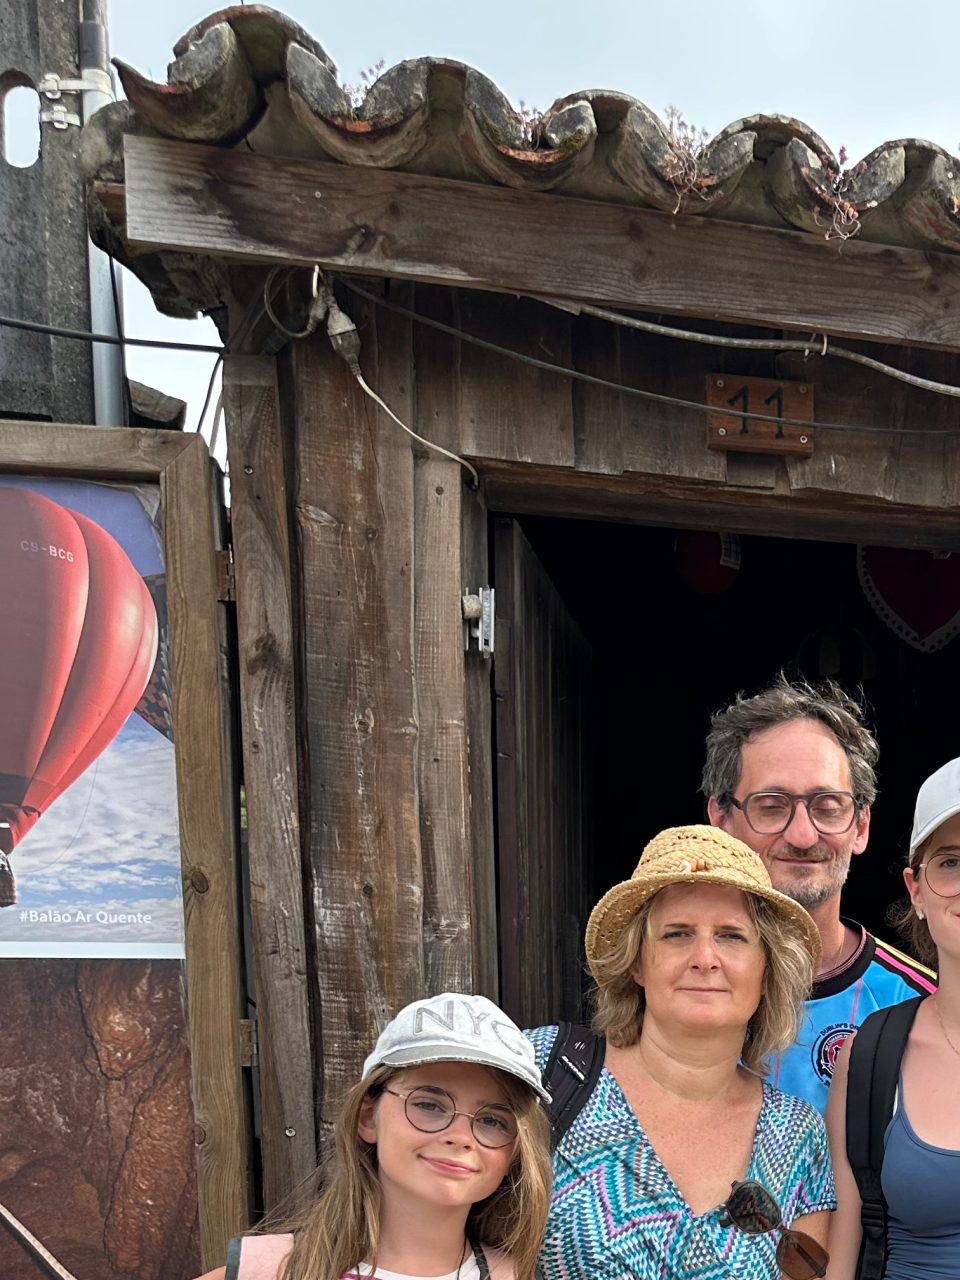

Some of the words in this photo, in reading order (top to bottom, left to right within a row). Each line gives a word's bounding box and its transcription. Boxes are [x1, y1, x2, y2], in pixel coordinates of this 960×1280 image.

[727, 385, 784, 438] 11
[20, 540, 74, 562] CS-BCG
[20, 910, 71, 924] #Balão
[75, 911, 92, 923] Ar
[96, 911, 152, 925] Quente
[413, 1000, 524, 1057] NYC
